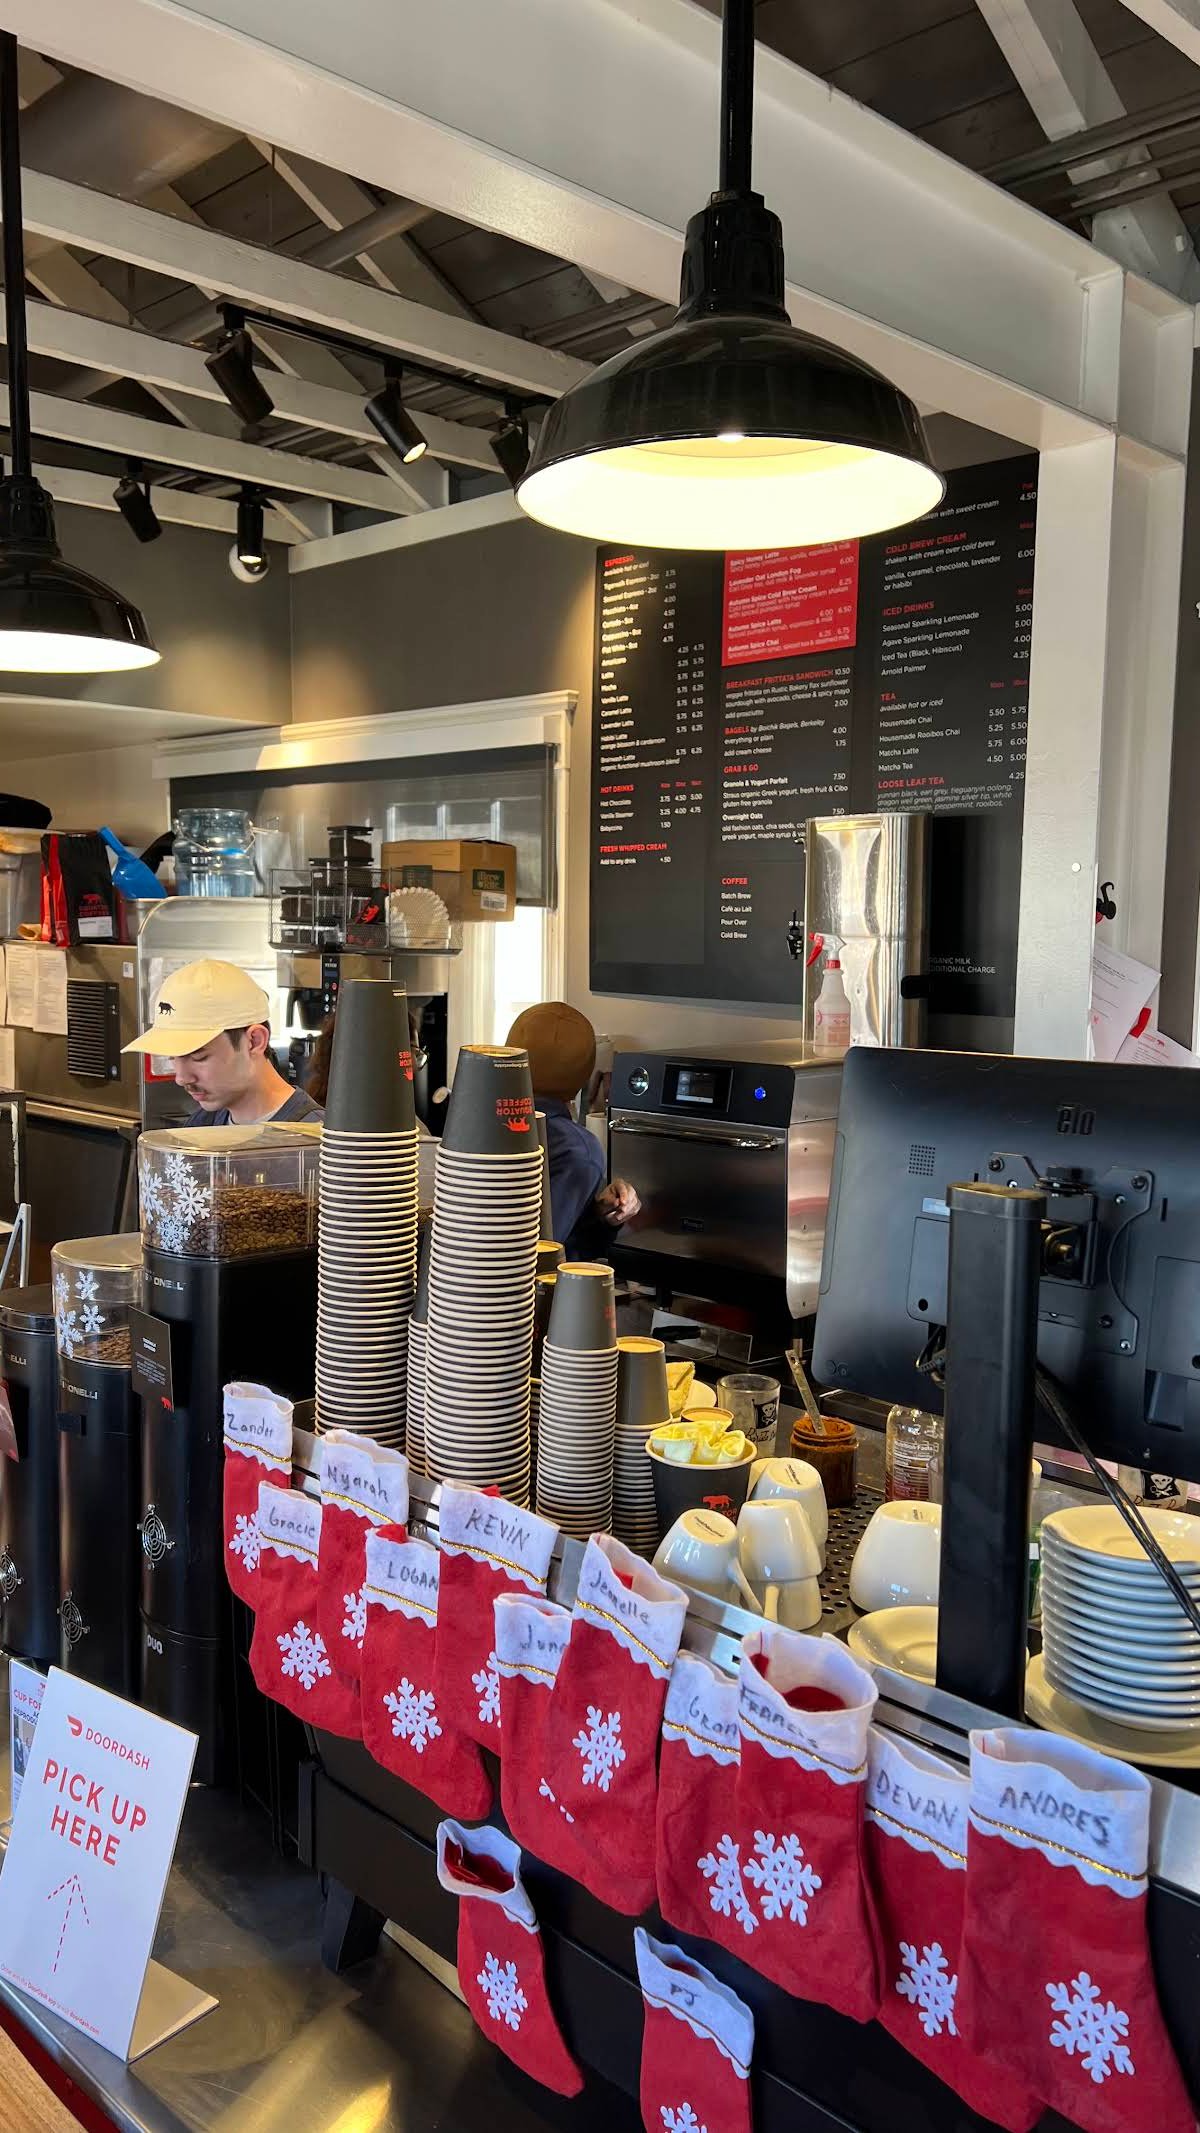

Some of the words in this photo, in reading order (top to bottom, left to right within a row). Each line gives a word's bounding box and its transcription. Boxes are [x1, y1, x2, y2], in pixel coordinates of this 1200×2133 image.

[1020, 492, 1036, 501] 4.50
[939, 508, 954, 516] with
[955, 503, 976, 514] sweet
[976, 500, 999, 509] cream
[885, 543, 907, 554] COLD
[909, 539, 934, 549] BREW
[936, 532, 966, 544] CREAM
[884, 555, 907, 565] shaken
[907, 552, 922, 560] with
[923, 549, 944, 558] cream
[945, 546, 960, 554] over
[961, 541, 977, 551] cold
[977, 540, 995, 548] brew
[1018, 549, 1035, 558] 6.00
[840, 556, 854, 565] 6.00
[883, 606, 902, 615] ICED
[903, 601, 933, 612] DRINKS
[1016, 604, 1032, 612] 5.00
[882, 621, 910, 632] Seasonal
[911, 617, 942, 627] Sparkling
[943, 612, 979, 622] Lemonade
[1015, 619, 1032, 628] 5.00
[881, 638, 902, 647] Agave
[902, 633, 933, 643] Sparkling
[934, 627, 969, 639] Lemonade
[1014, 634, 1031, 643] 4.00
[881, 652, 895, 661] Iced
[1013, 651, 1029, 659] 4.25
[835, 667, 850, 675] 10.50
[880, 666, 902, 675] Arnold
[726, 677, 763, 688] BREAKFAST
[763, 674, 794, 683] FRITTATA
[794, 669, 833, 680] SANDWICH
[879, 703, 907, 712] available
[928, 698, 943, 706] iced
[1012, 706, 1026, 714] 5.75
[989, 708, 1005, 716] 5.50
[879, 717, 916, 727] Housemade
[879, 732, 916, 742] Housemade
[1010, 738, 1026, 746] 6.00
[878, 779, 904, 788] LOOSE
[906, 777, 926, 786] LEAF
[928, 776, 944, 784] TEA
[751, 798, 772, 806] granola
[496, 1106, 534, 1116] EQUATOR
[14, 1689, 27, 1702] CUP
[85, 1727, 151, 1771] DOORDASH
[42, 1758, 104, 1814] PICK
[111, 1794, 148, 1833] UP
[876, 1769, 958, 1828] DEVAN
[999, 1786, 1111, 1848] ANDRES
[50, 1804, 121, 1867] HERE
